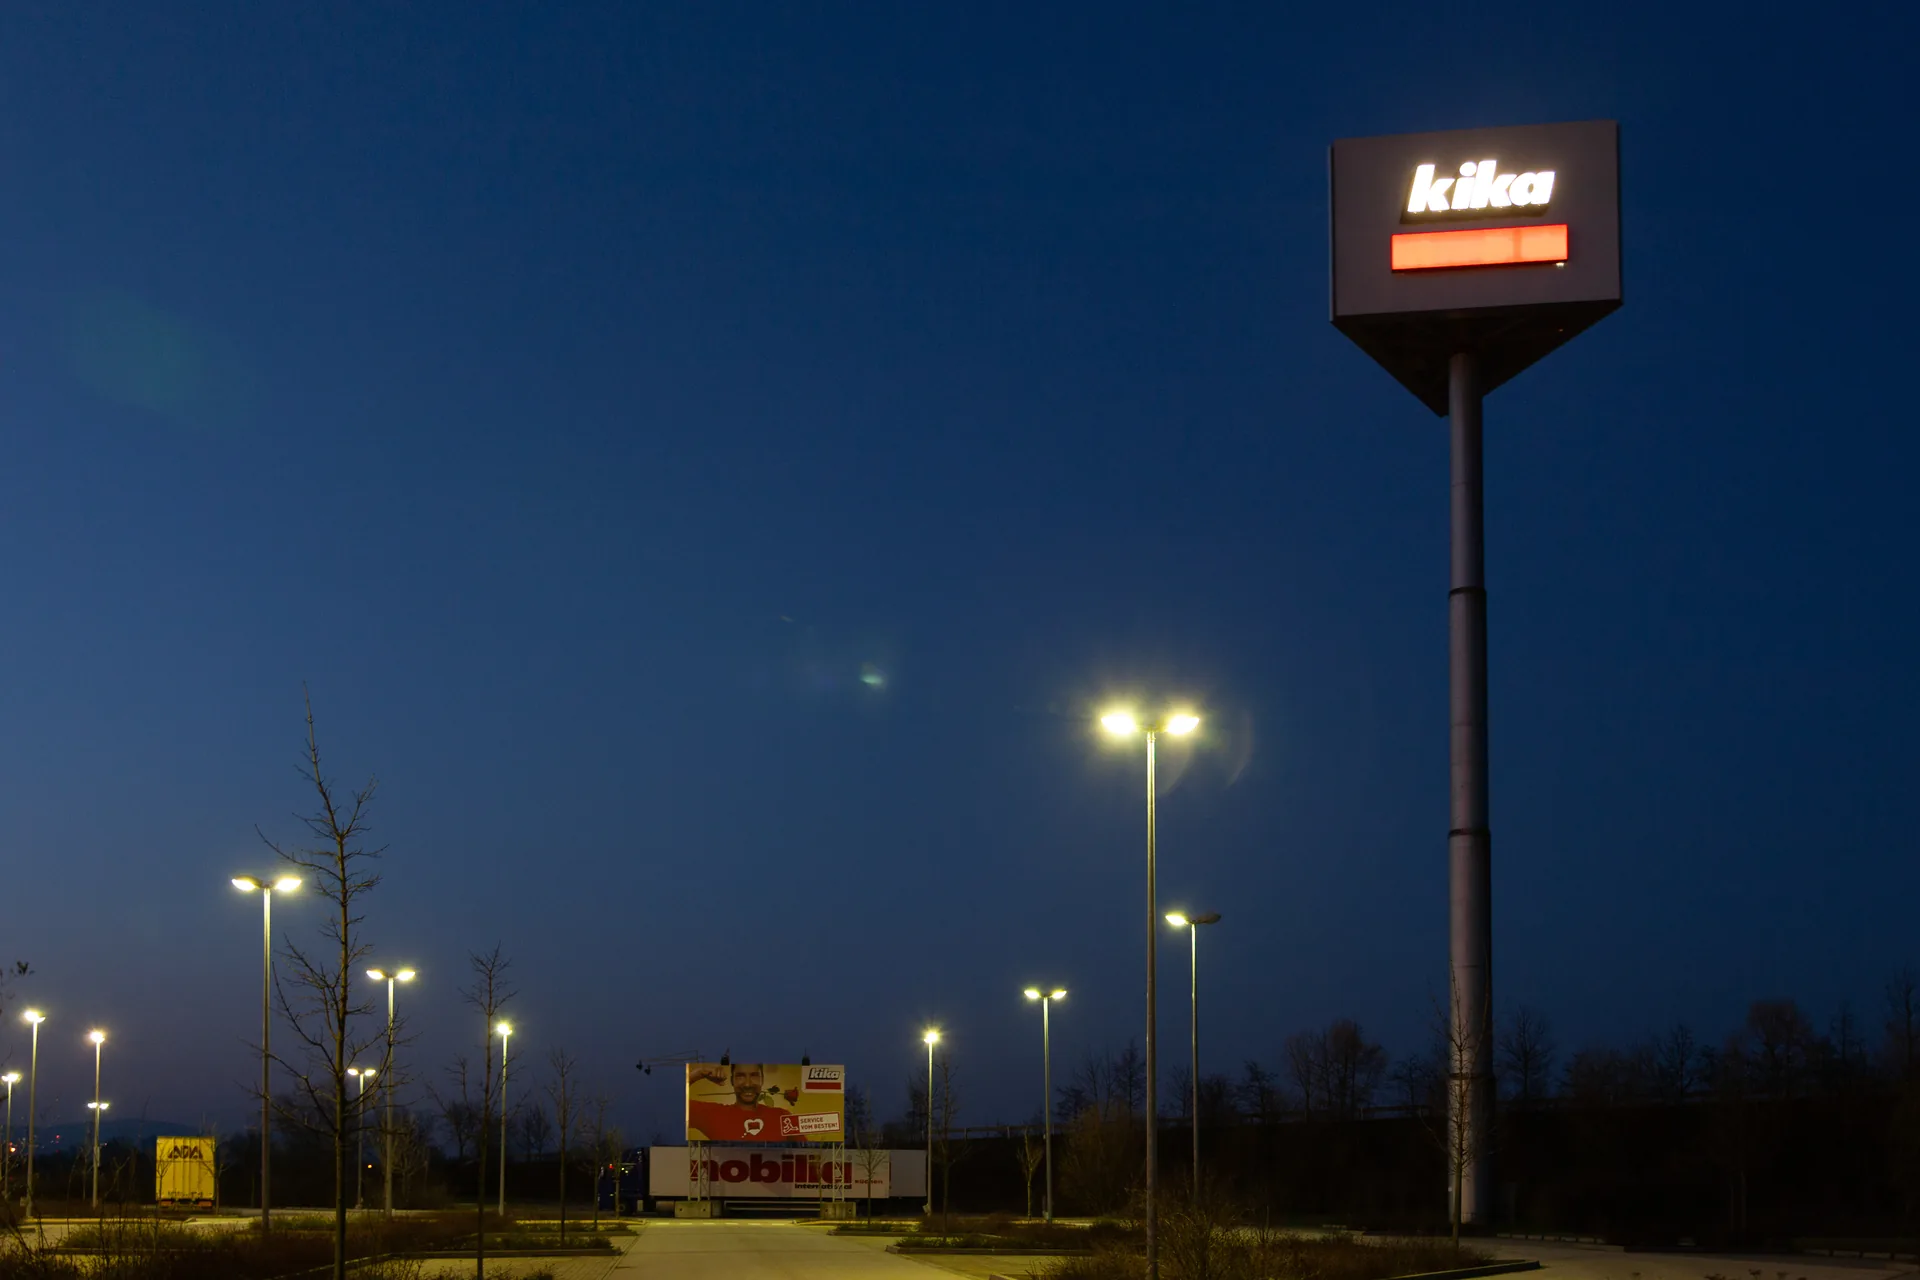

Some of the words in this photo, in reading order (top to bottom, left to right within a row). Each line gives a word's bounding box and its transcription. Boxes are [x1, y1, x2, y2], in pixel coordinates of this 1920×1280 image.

[1407, 160, 1556, 211] kika
[809, 1068, 840, 1080] kika
[168, 1145, 203, 1158] ADA
